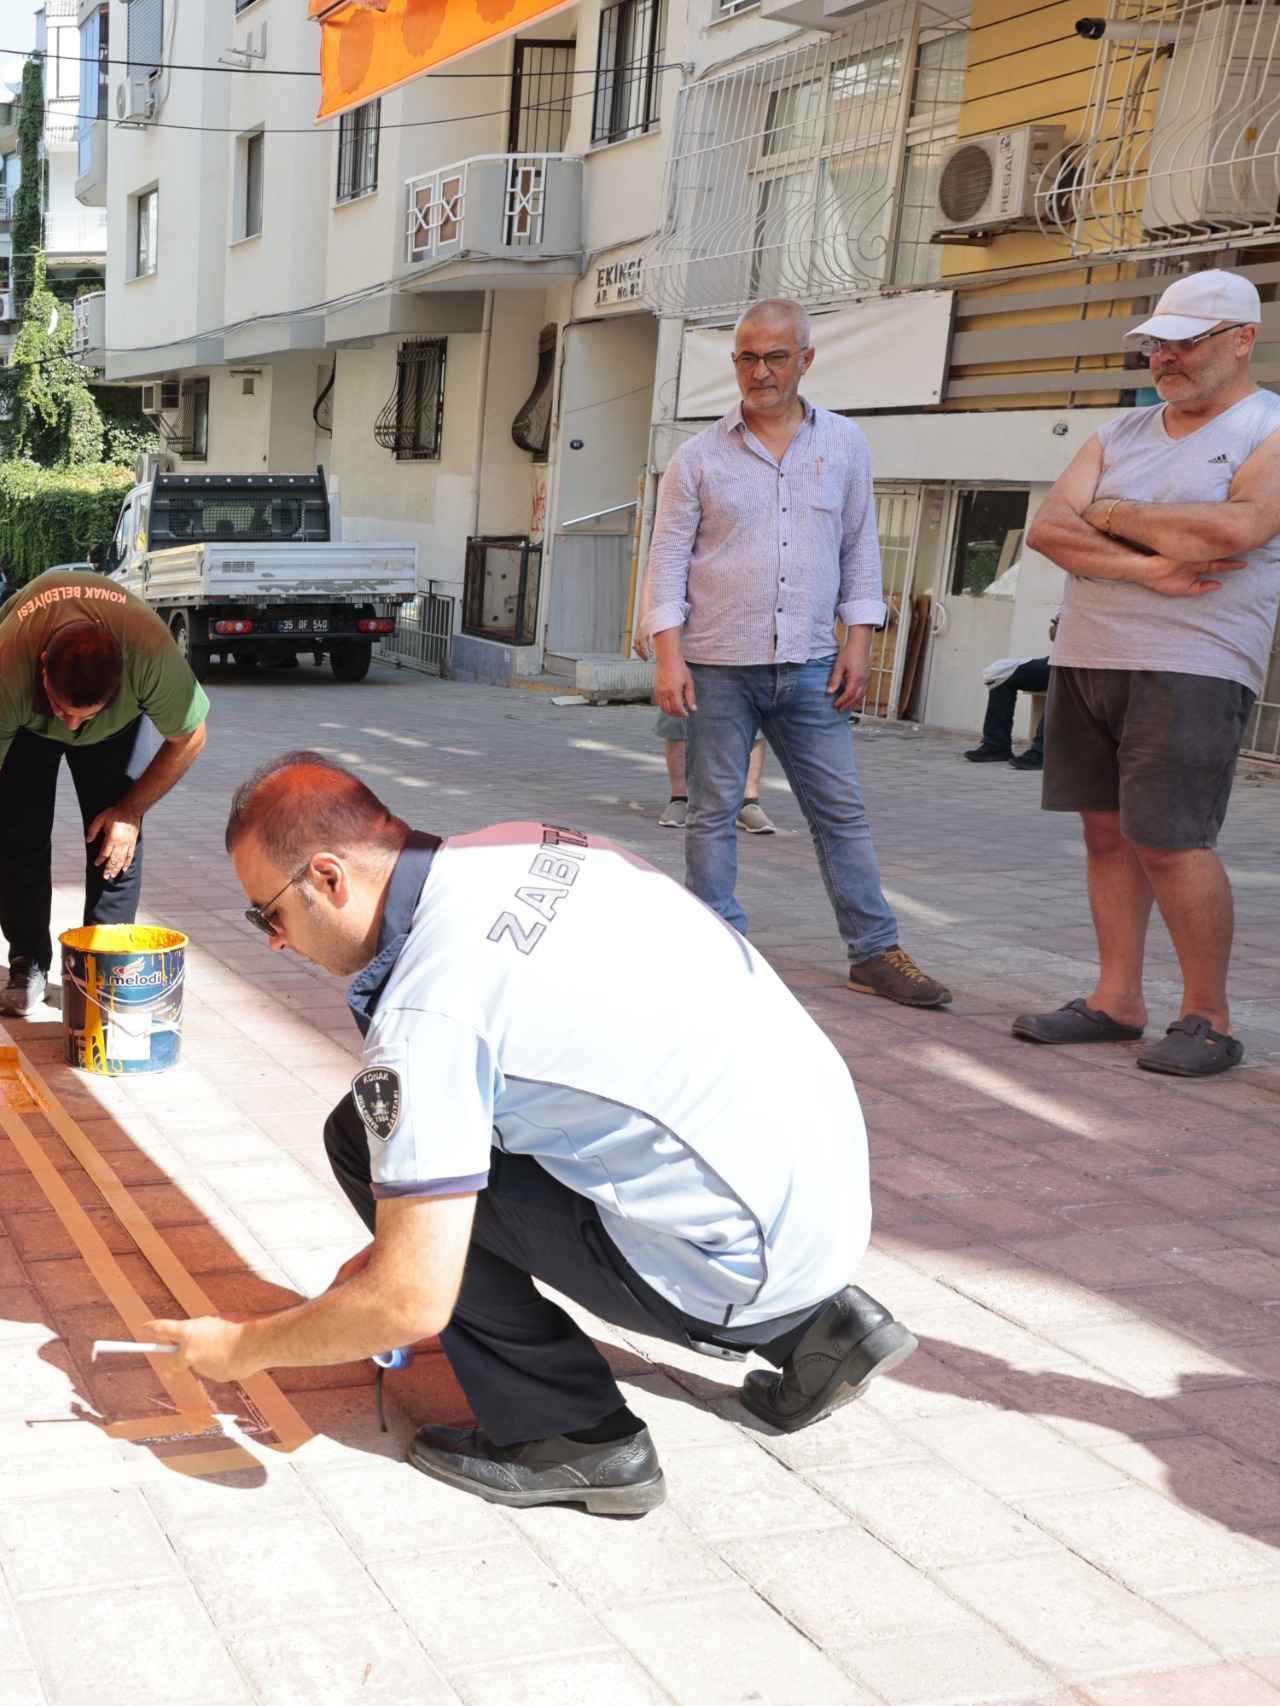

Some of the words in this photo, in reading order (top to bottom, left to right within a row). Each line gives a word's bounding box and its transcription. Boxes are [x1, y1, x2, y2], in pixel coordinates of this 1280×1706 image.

[1001, 149, 1014, 213] REGAL
[84, 587, 126, 604] KONAK
[17, 586, 81, 622] BELEDİYESİ
[283, 620, 293, 629] 35
[313, 619, 328, 629] 540
[110, 971, 162, 987] melodi
[363, 1072, 389, 1084] KONAK
